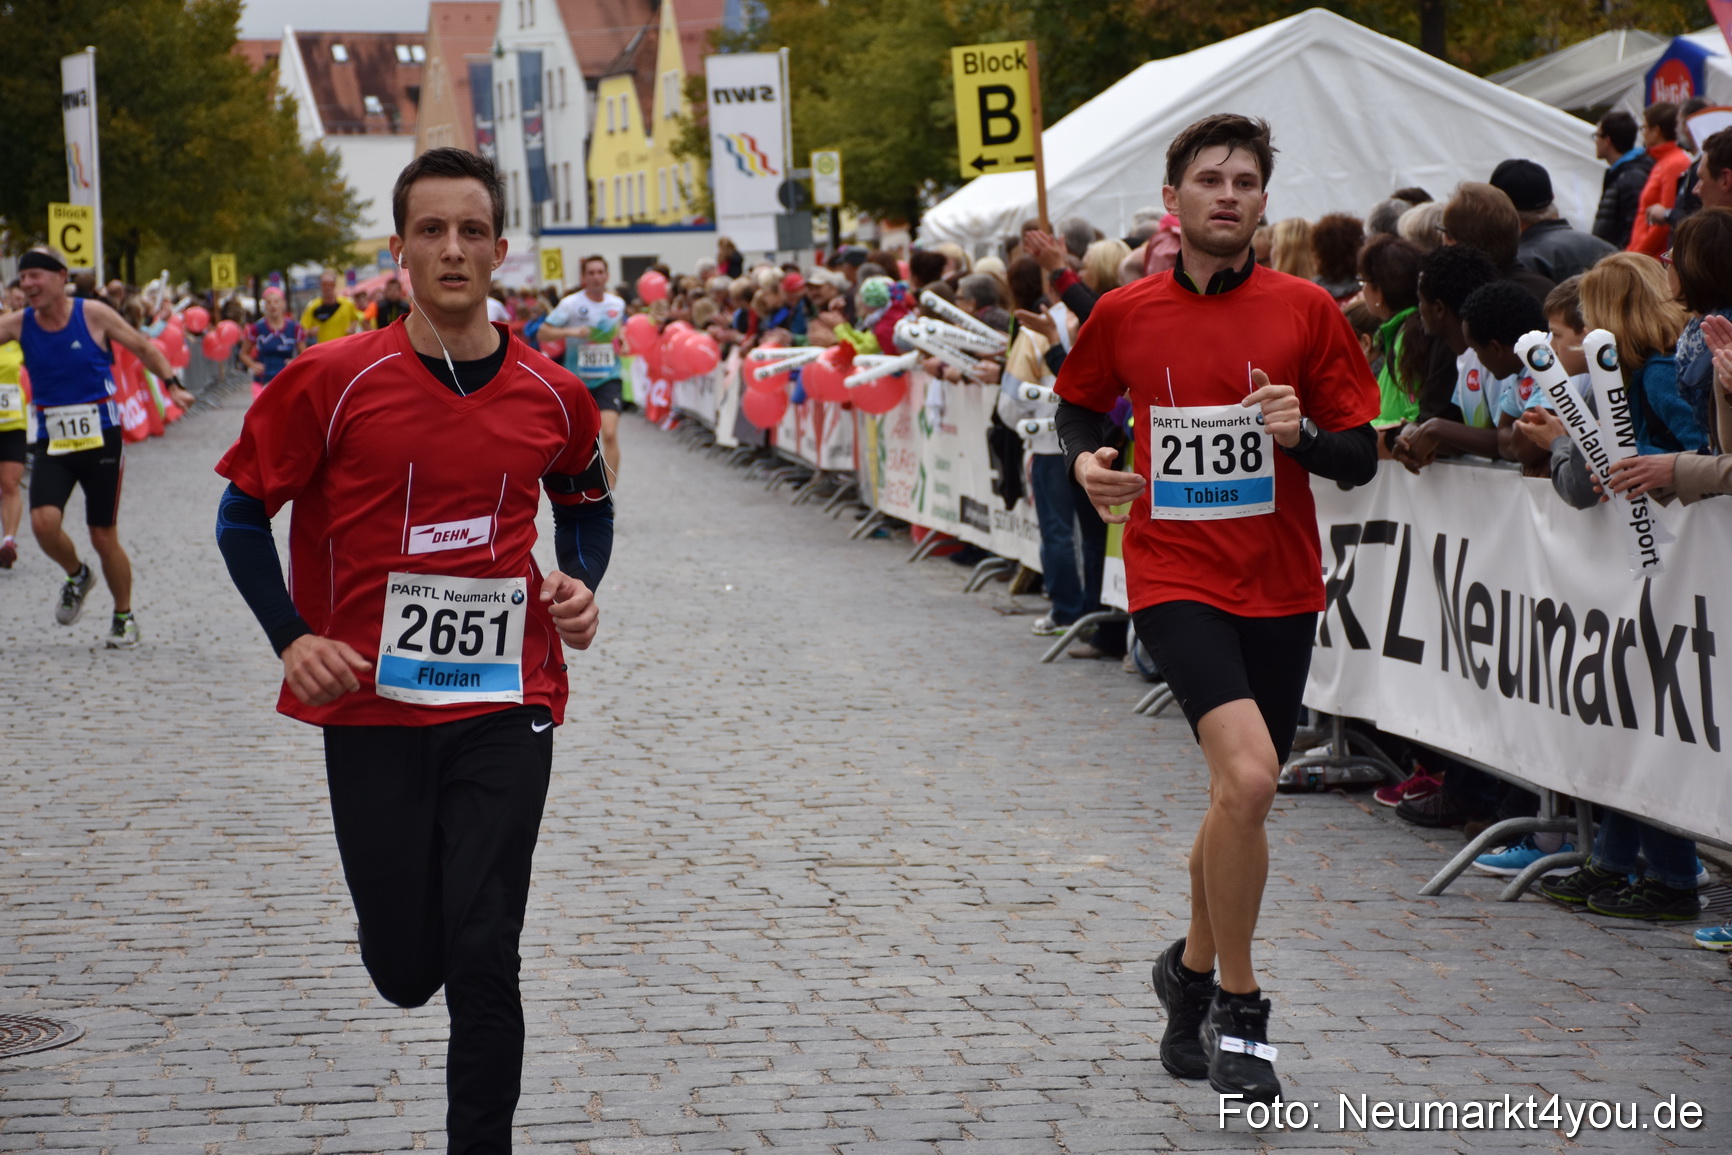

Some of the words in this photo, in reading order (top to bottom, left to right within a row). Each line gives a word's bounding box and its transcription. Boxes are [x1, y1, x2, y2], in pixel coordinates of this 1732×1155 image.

[963, 48, 1028, 75] Block
[978, 83, 1021, 146] B
[54, 207, 88, 219] Block
[60, 223, 82, 254] C
[217, 264, 230, 282] D
[57, 417, 91, 438] 116
[1153, 417, 1189, 429] PARTL
[1191, 416, 1251, 429] Neumarkt
[1607, 387, 1637, 448] BMW
[1161, 431, 1263, 476] 2138
[1184, 487, 1239, 504] Tobias
[431, 528, 470, 544] DEHN
[391, 583, 440, 601] PARTL
[443, 589, 507, 603] Neumarkt
[396, 604, 509, 657] 2651
[1433, 533, 1721, 753] Neumarkt
[418, 667, 480, 687] Florian
